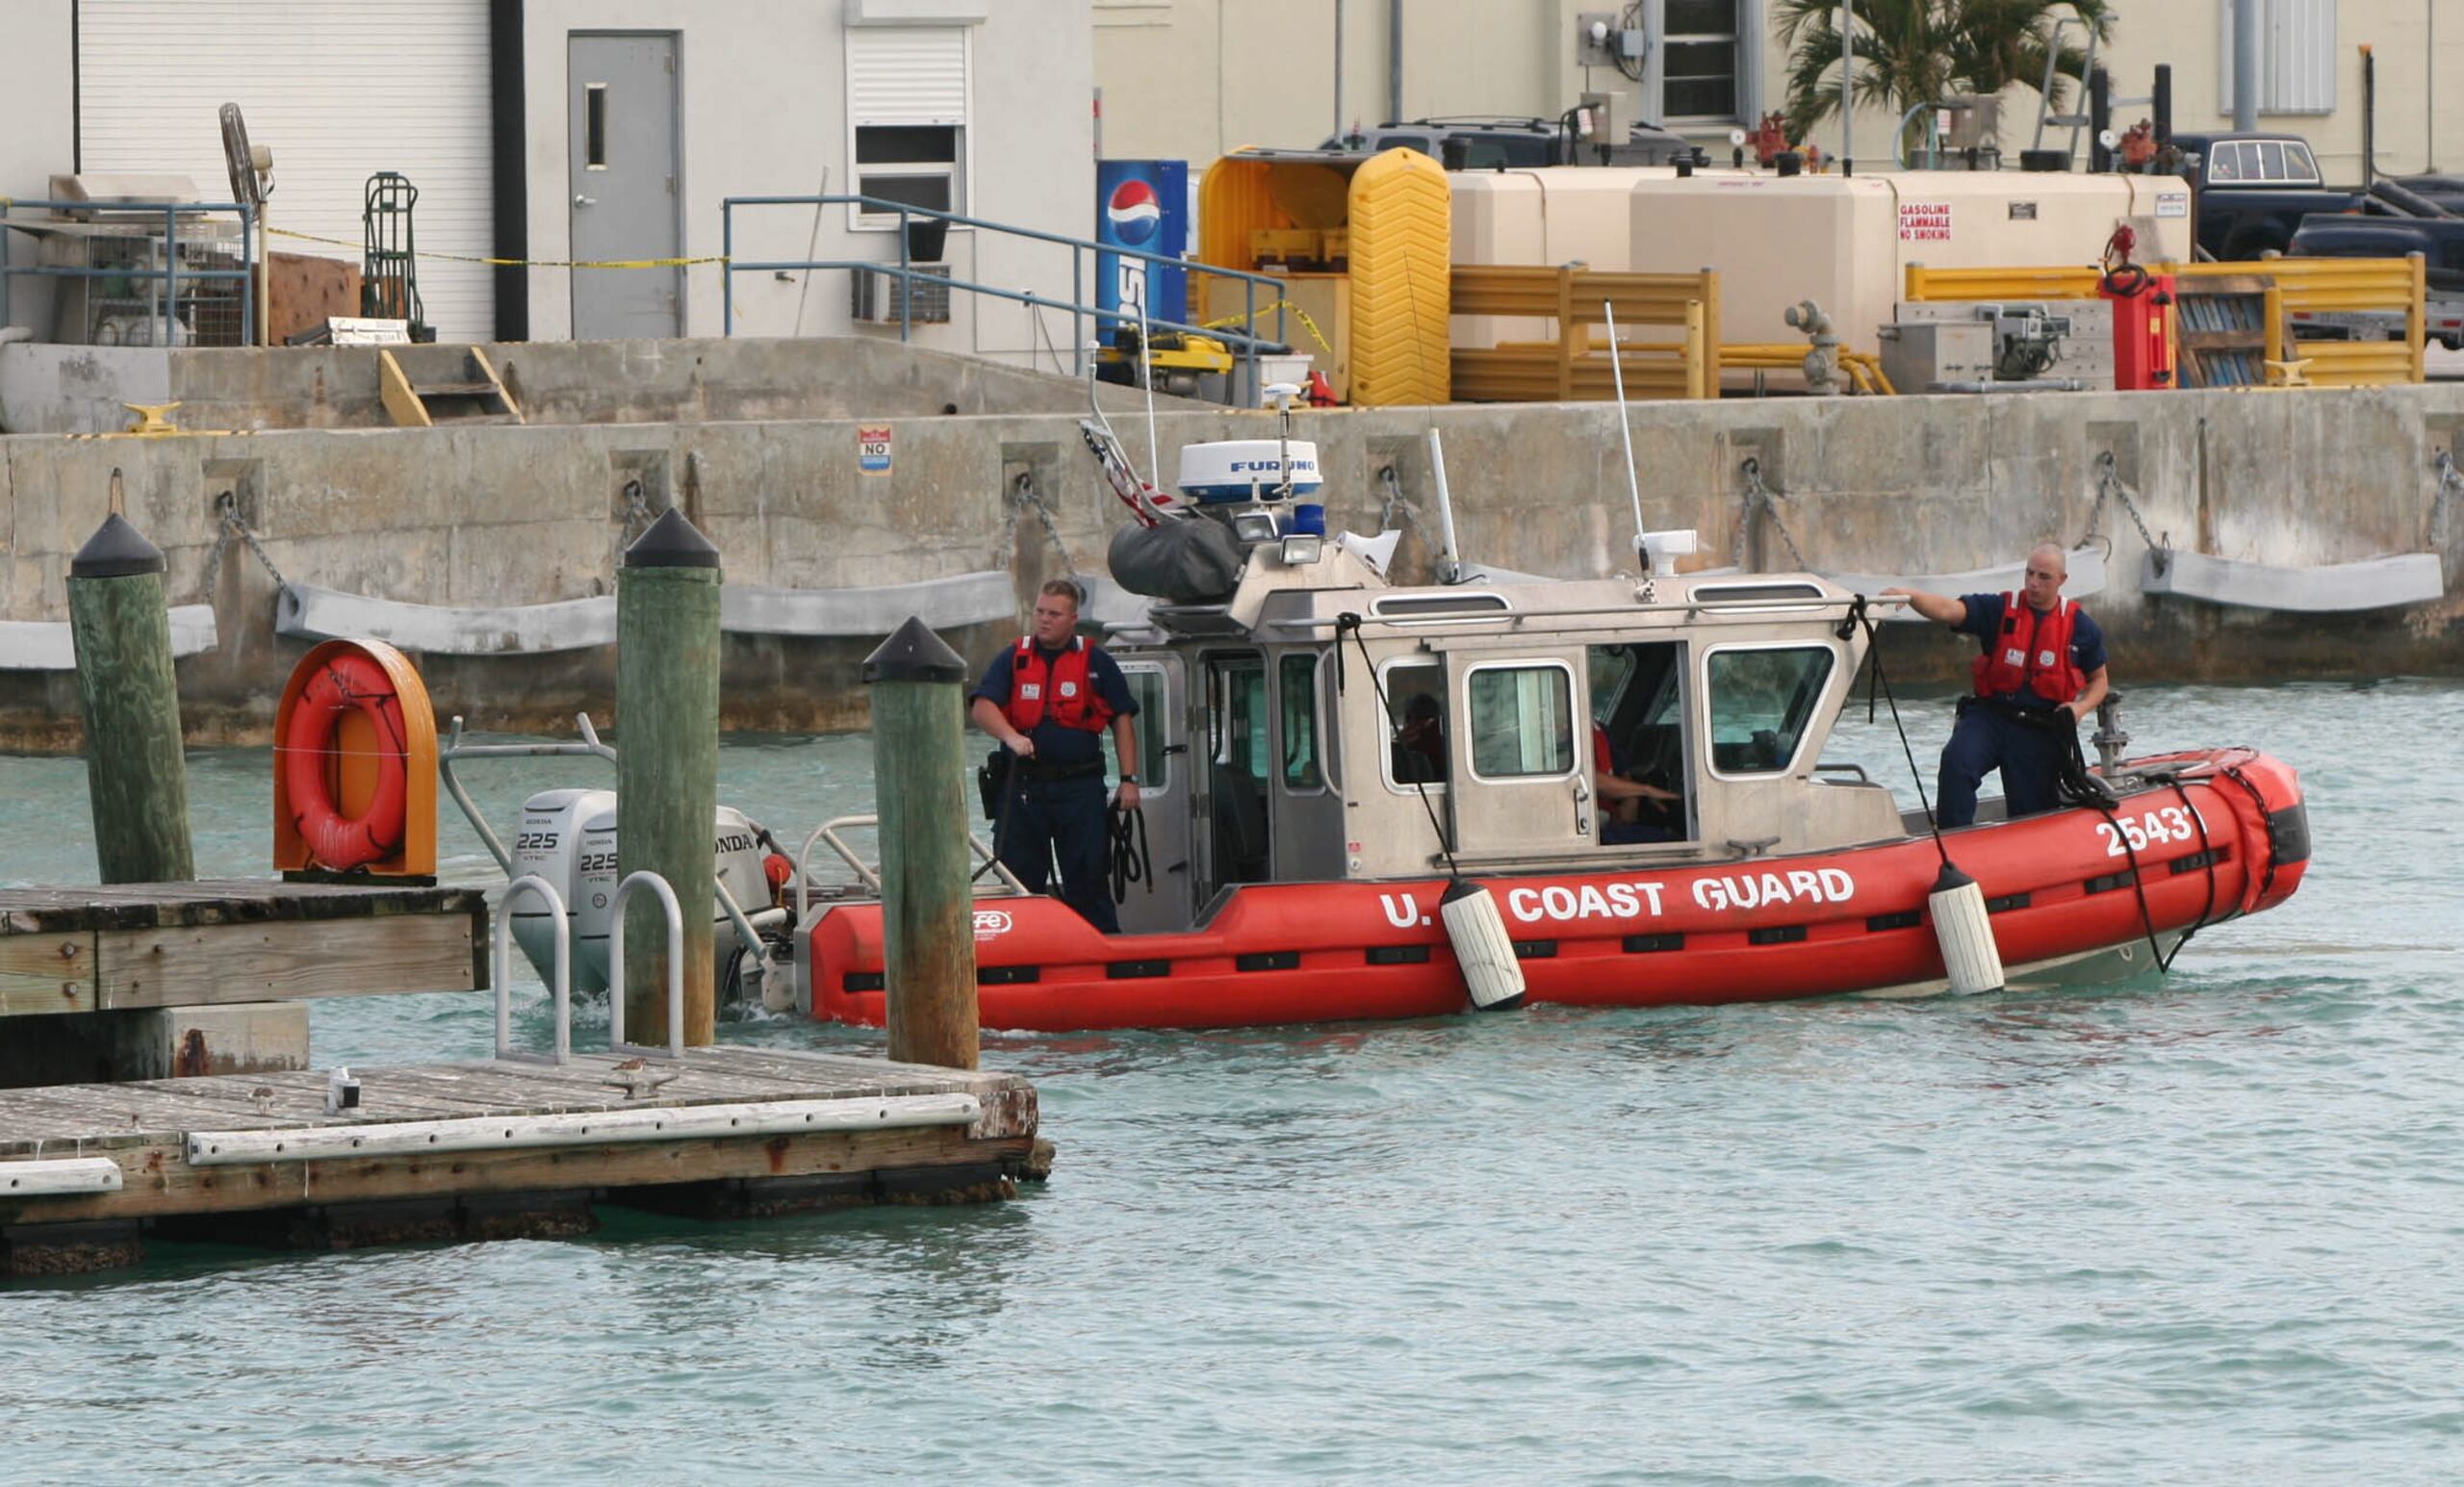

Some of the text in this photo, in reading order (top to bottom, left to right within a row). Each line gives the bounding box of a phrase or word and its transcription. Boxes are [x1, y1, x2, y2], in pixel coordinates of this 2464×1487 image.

[1900, 204, 1950, 215] GASOLINE
[1900, 216, 1950, 227] FLAMMABLE
[1900, 229, 1950, 240] NO SMOKING
[865, 444, 886, 454] NO
[516, 833, 559, 849] 225
[715, 833, 754, 855] NDA
[580, 853, 617, 872] 225
[1508, 882, 1665, 922] COAST
[1692, 867, 1855, 912] GUARD
